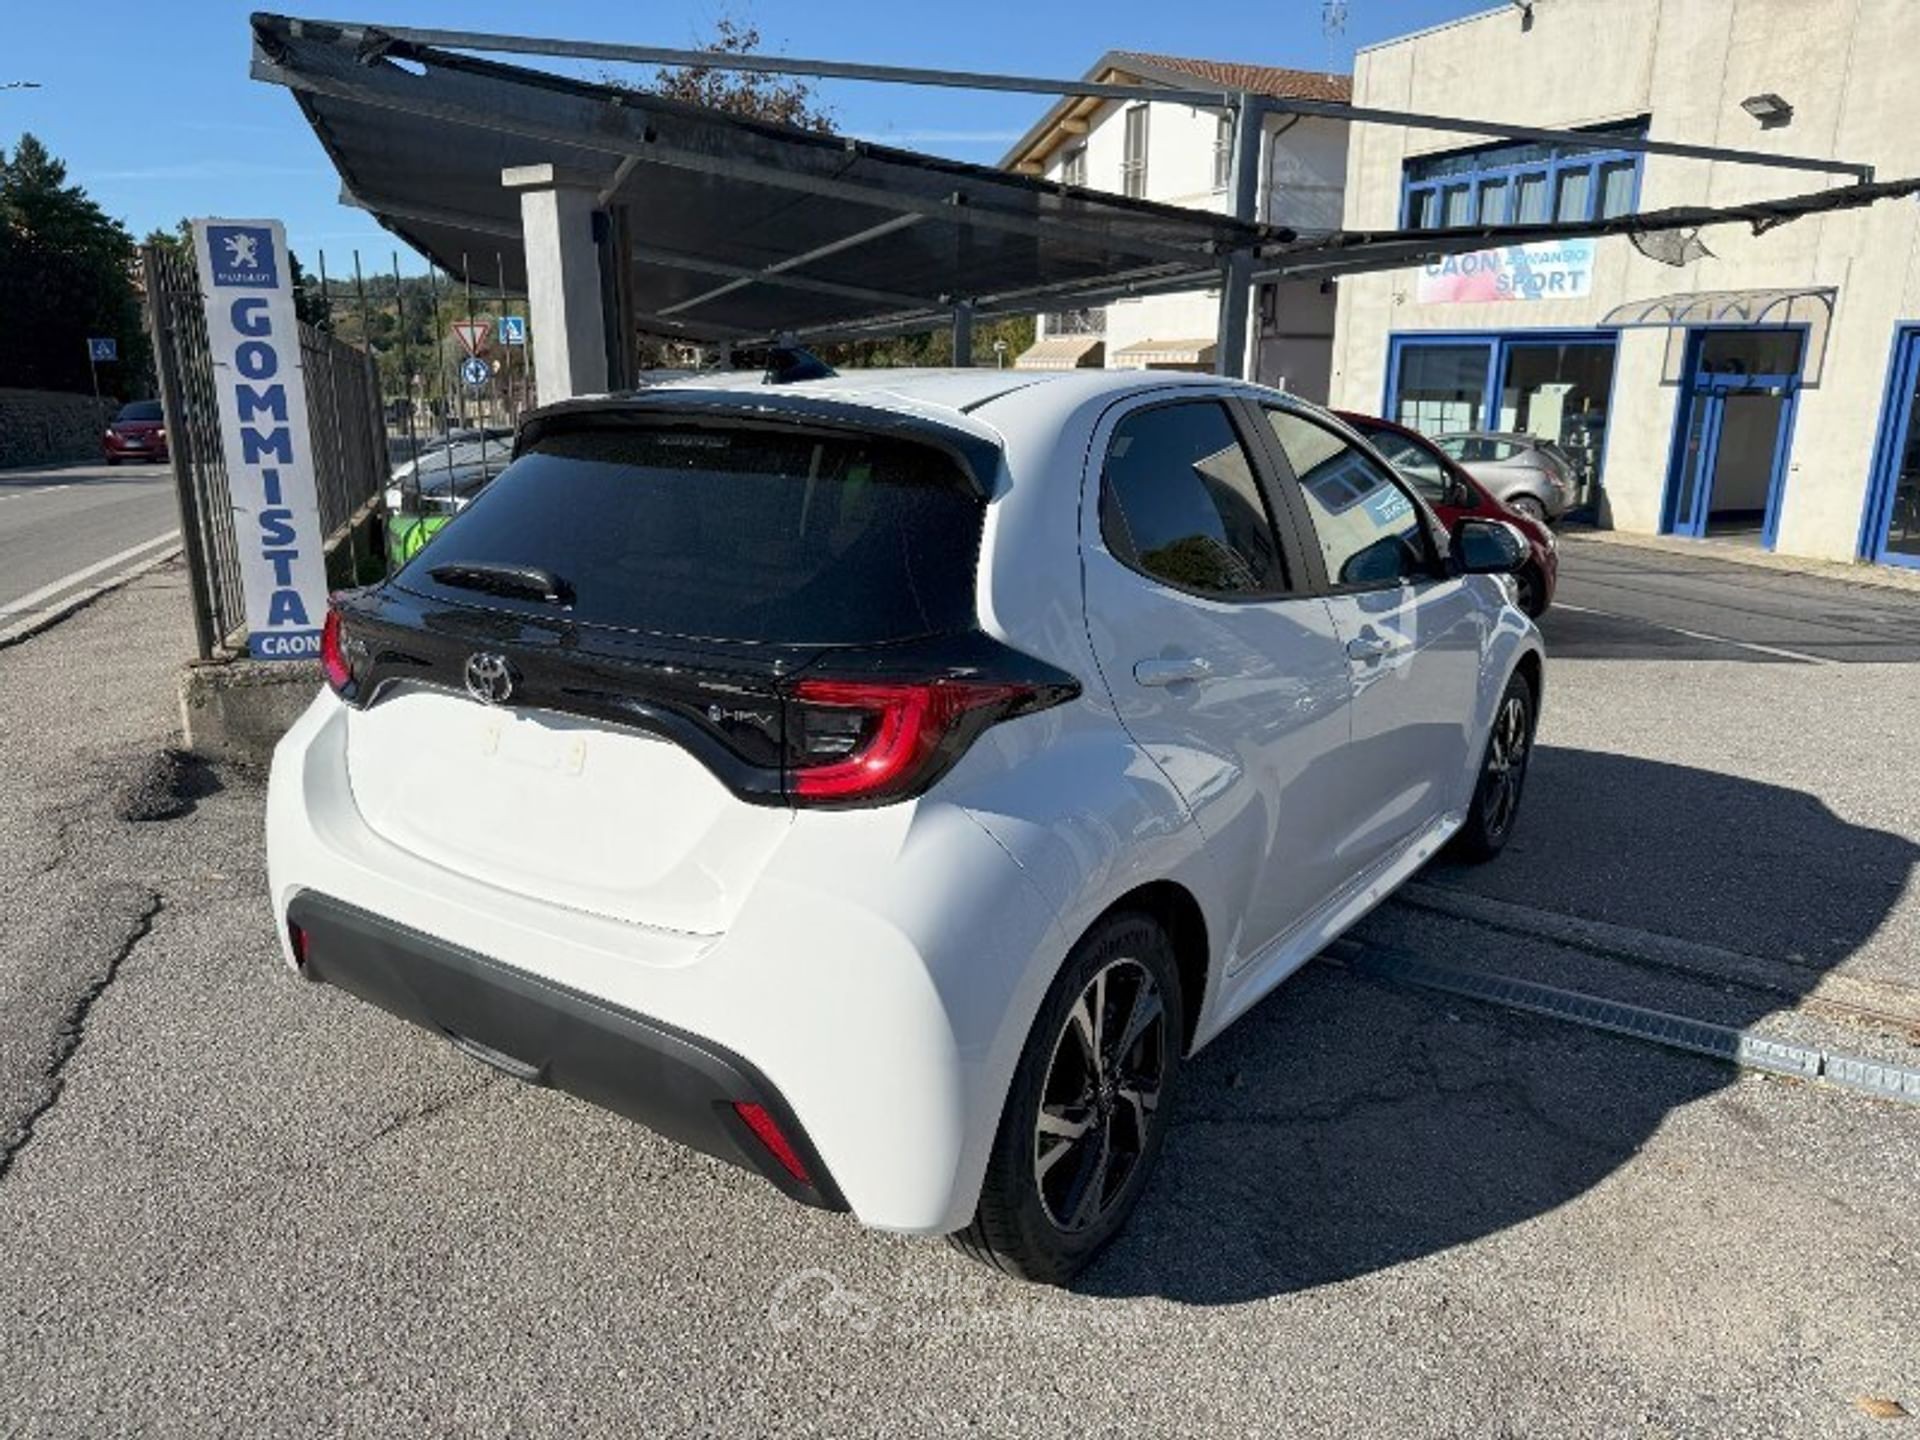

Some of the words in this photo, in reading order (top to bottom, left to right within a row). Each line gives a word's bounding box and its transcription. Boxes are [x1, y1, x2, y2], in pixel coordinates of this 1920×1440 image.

[1496, 271, 1585, 292] SPORT
[231, 298, 310, 625] GOMMISTA
[262, 636, 321, 654] CAON
